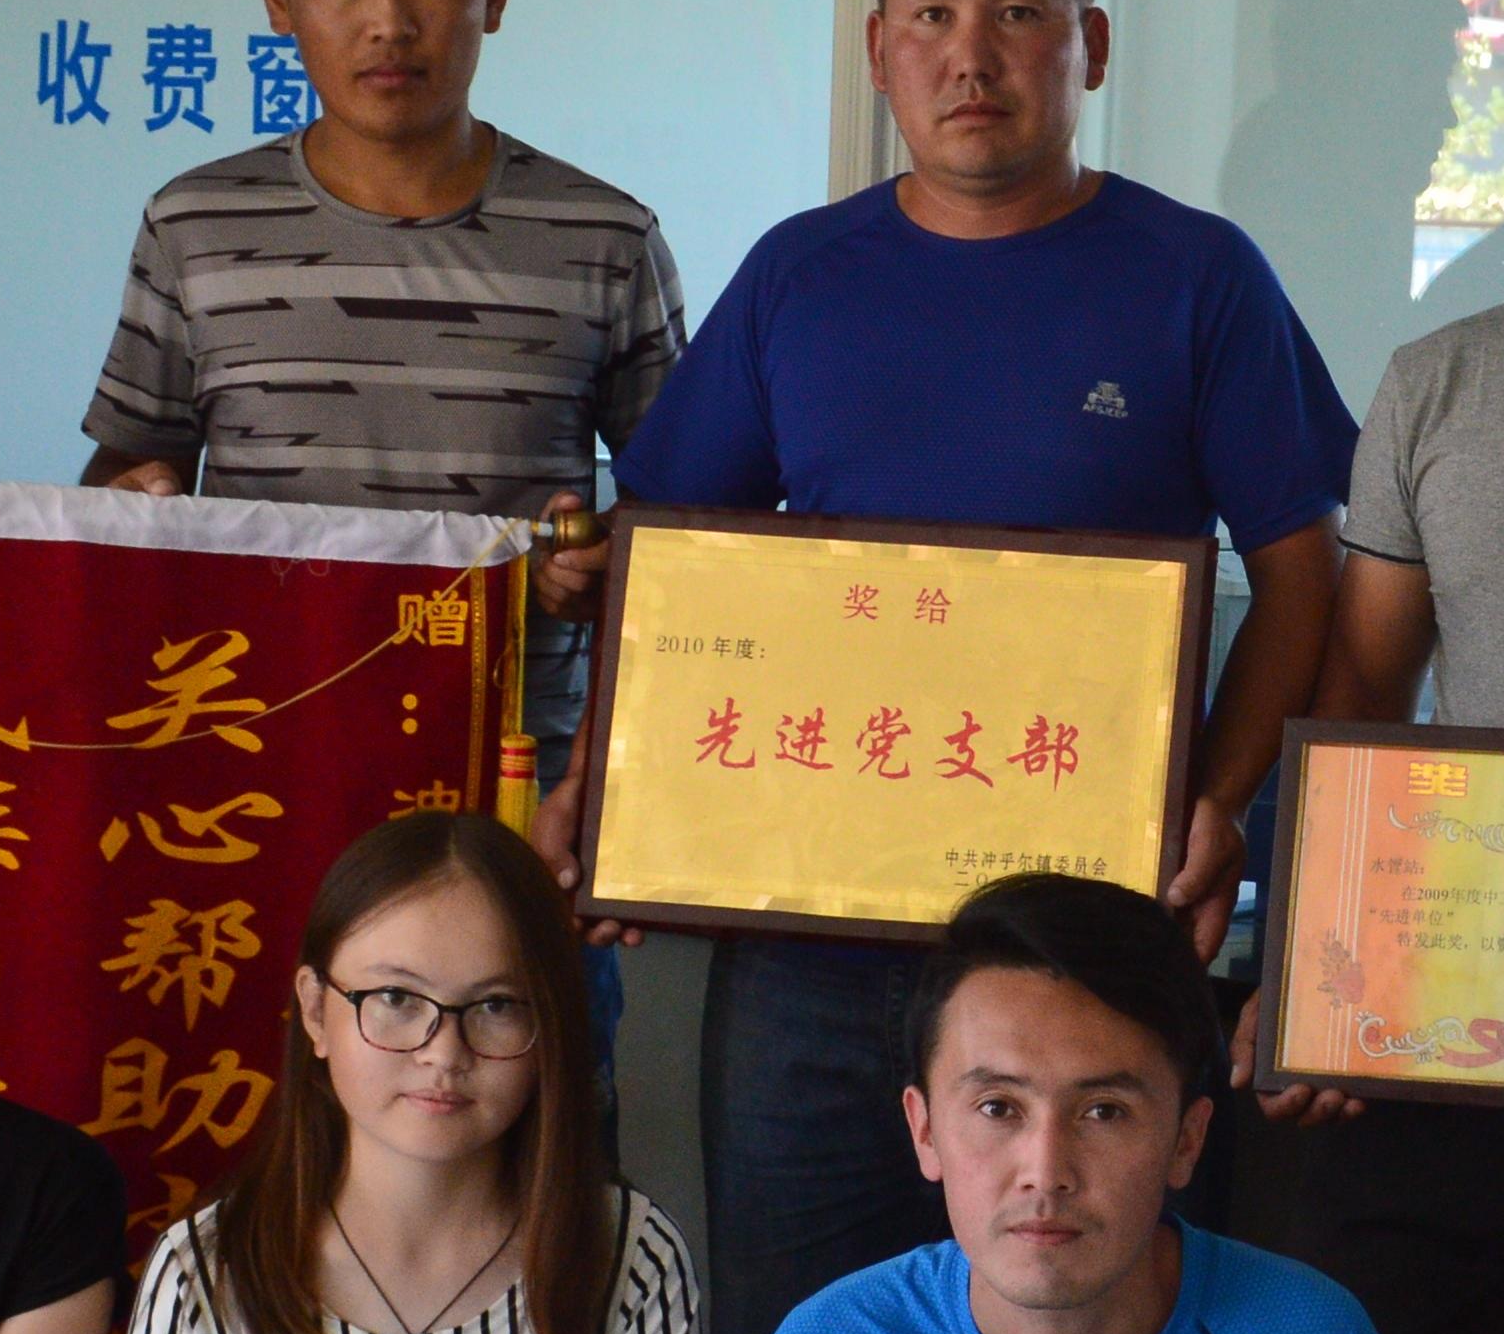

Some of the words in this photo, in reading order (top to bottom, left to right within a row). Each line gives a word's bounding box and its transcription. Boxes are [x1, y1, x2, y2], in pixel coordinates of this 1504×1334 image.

[844, 583, 953, 626] 奖给
[695, 697, 1080, 792] 先进党支部
